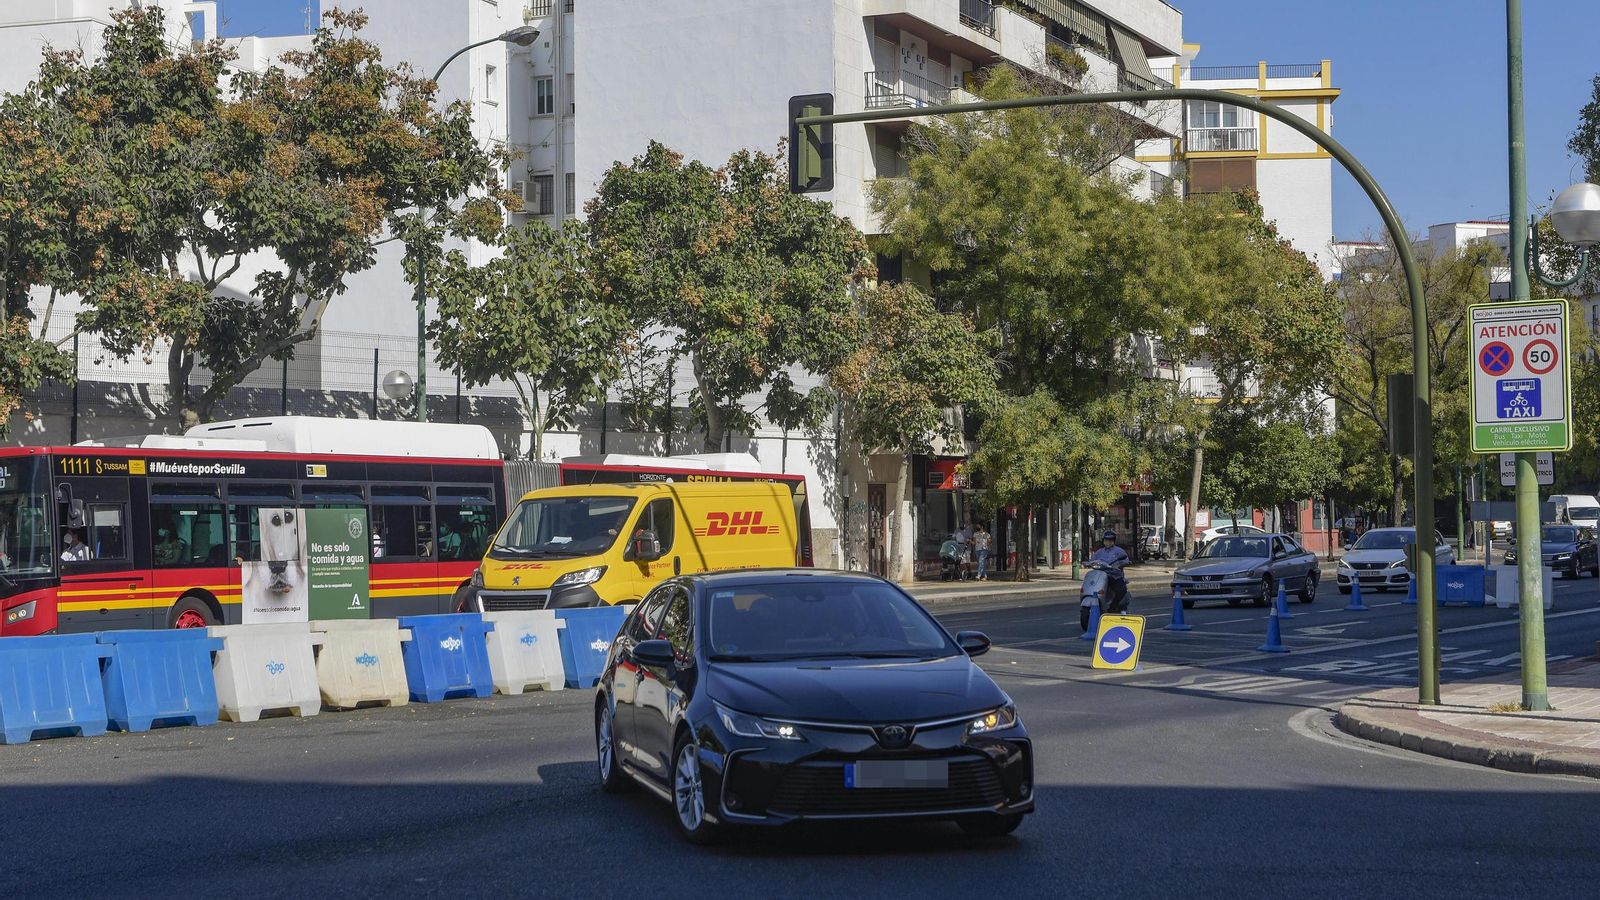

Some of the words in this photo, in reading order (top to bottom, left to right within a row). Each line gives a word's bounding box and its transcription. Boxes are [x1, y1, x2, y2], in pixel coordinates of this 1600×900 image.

[1480, 320, 1557, 338] ATENCIÓN
[1530, 350, 1551, 363] 50
[1504, 406, 1535, 418] TAXI
[1490, 426, 1513, 434] CARRIL
[1514, 425, 1550, 433] EXCLUSIVO
[61, 458, 90, 474] 1111
[149, 462, 246, 475] #MuéveteporSevilla
[706, 511, 769, 536] DHL
[311, 543, 322, 552] No
[334, 542, 350, 552] solo
[312, 554, 339, 564] comida
[340, 556, 345, 566] y
[346, 555, 364, 565] agua
